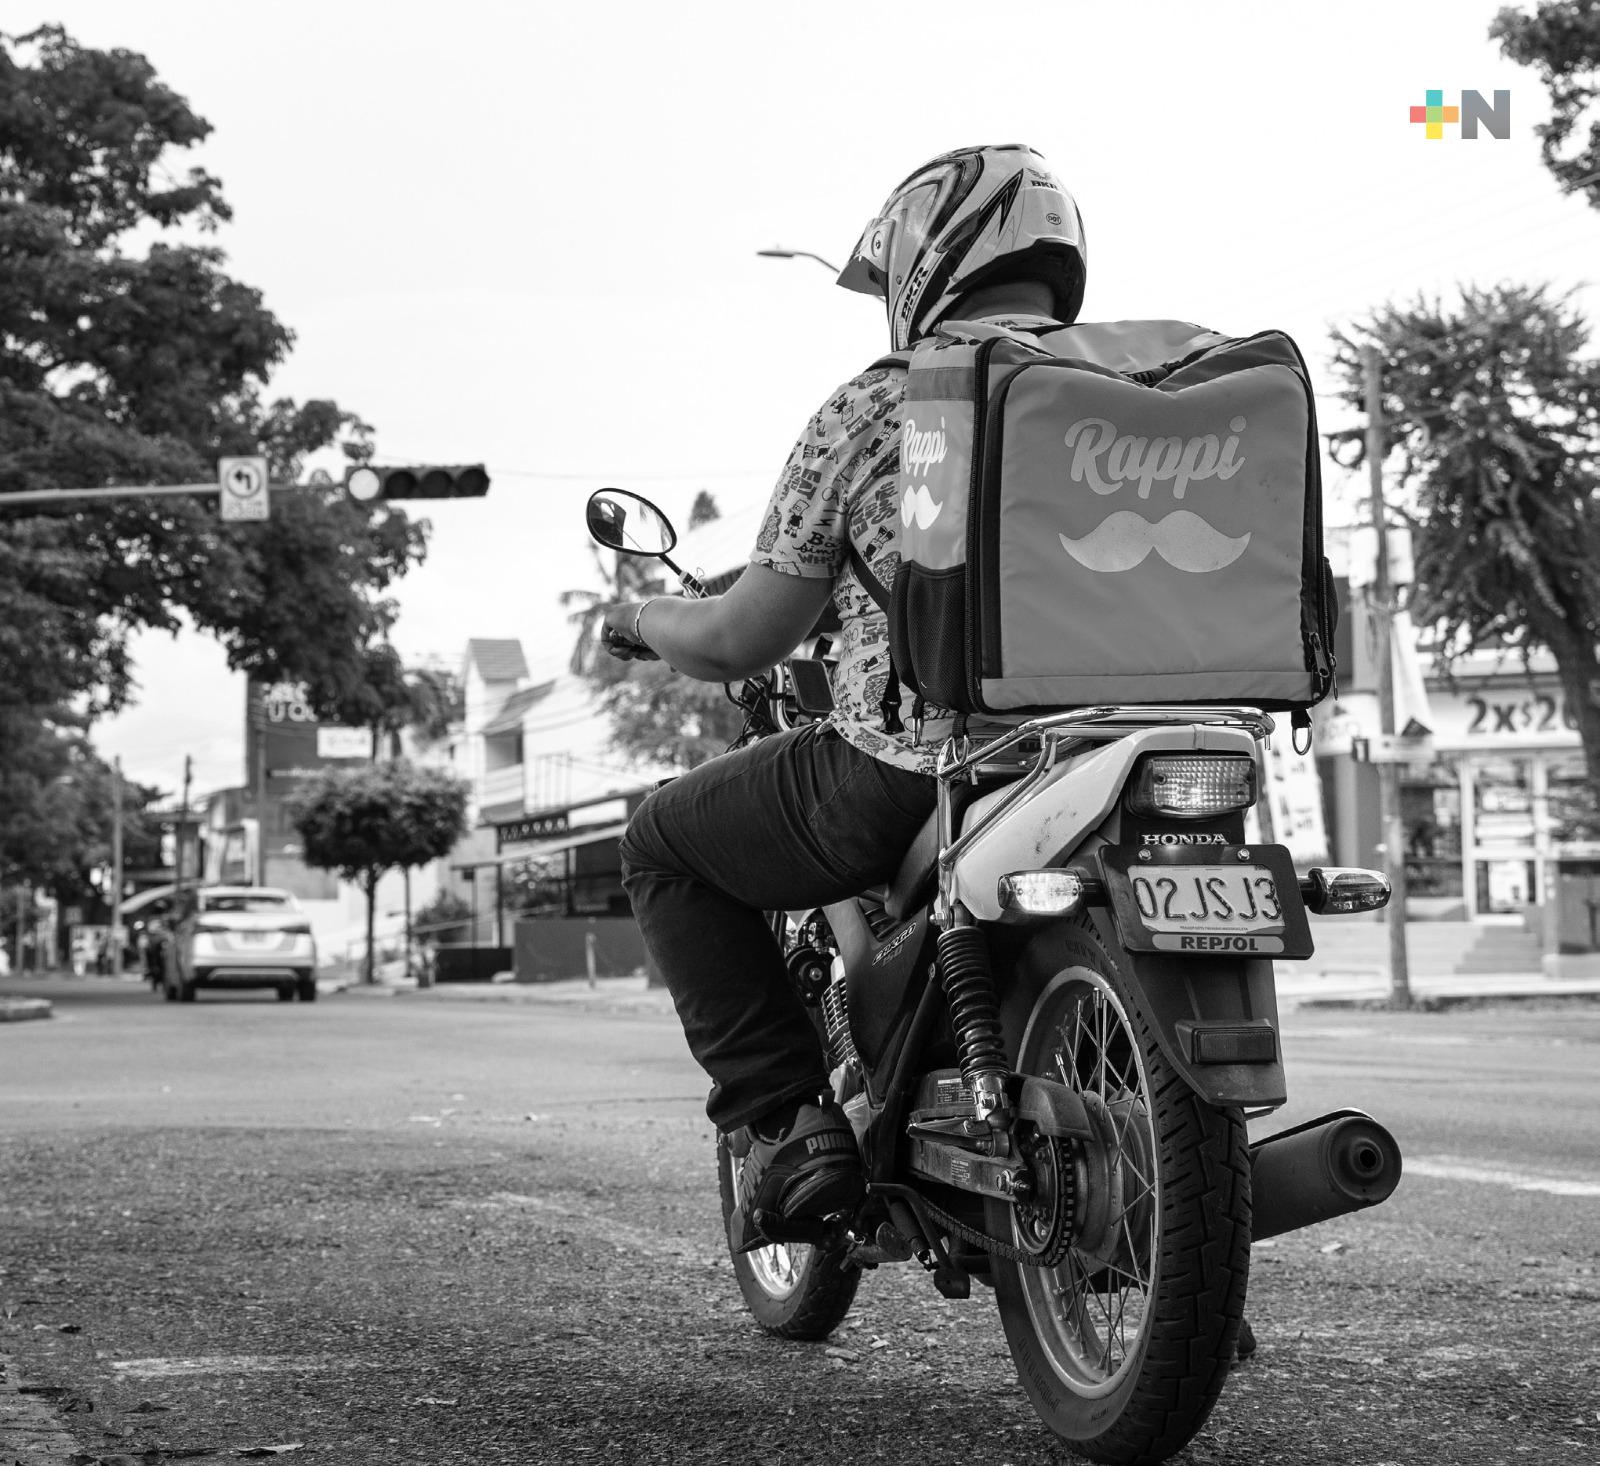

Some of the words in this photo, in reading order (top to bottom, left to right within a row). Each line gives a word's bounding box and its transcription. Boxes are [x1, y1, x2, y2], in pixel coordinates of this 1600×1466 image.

[903, 416, 948, 477] Rappi
[1064, 415, 1247, 499] Rappi
[1141, 833, 1230, 846] HONDA
[1132, 876, 1283, 920] 02JSJ3
[1180, 935, 1259, 951] REPSOL
